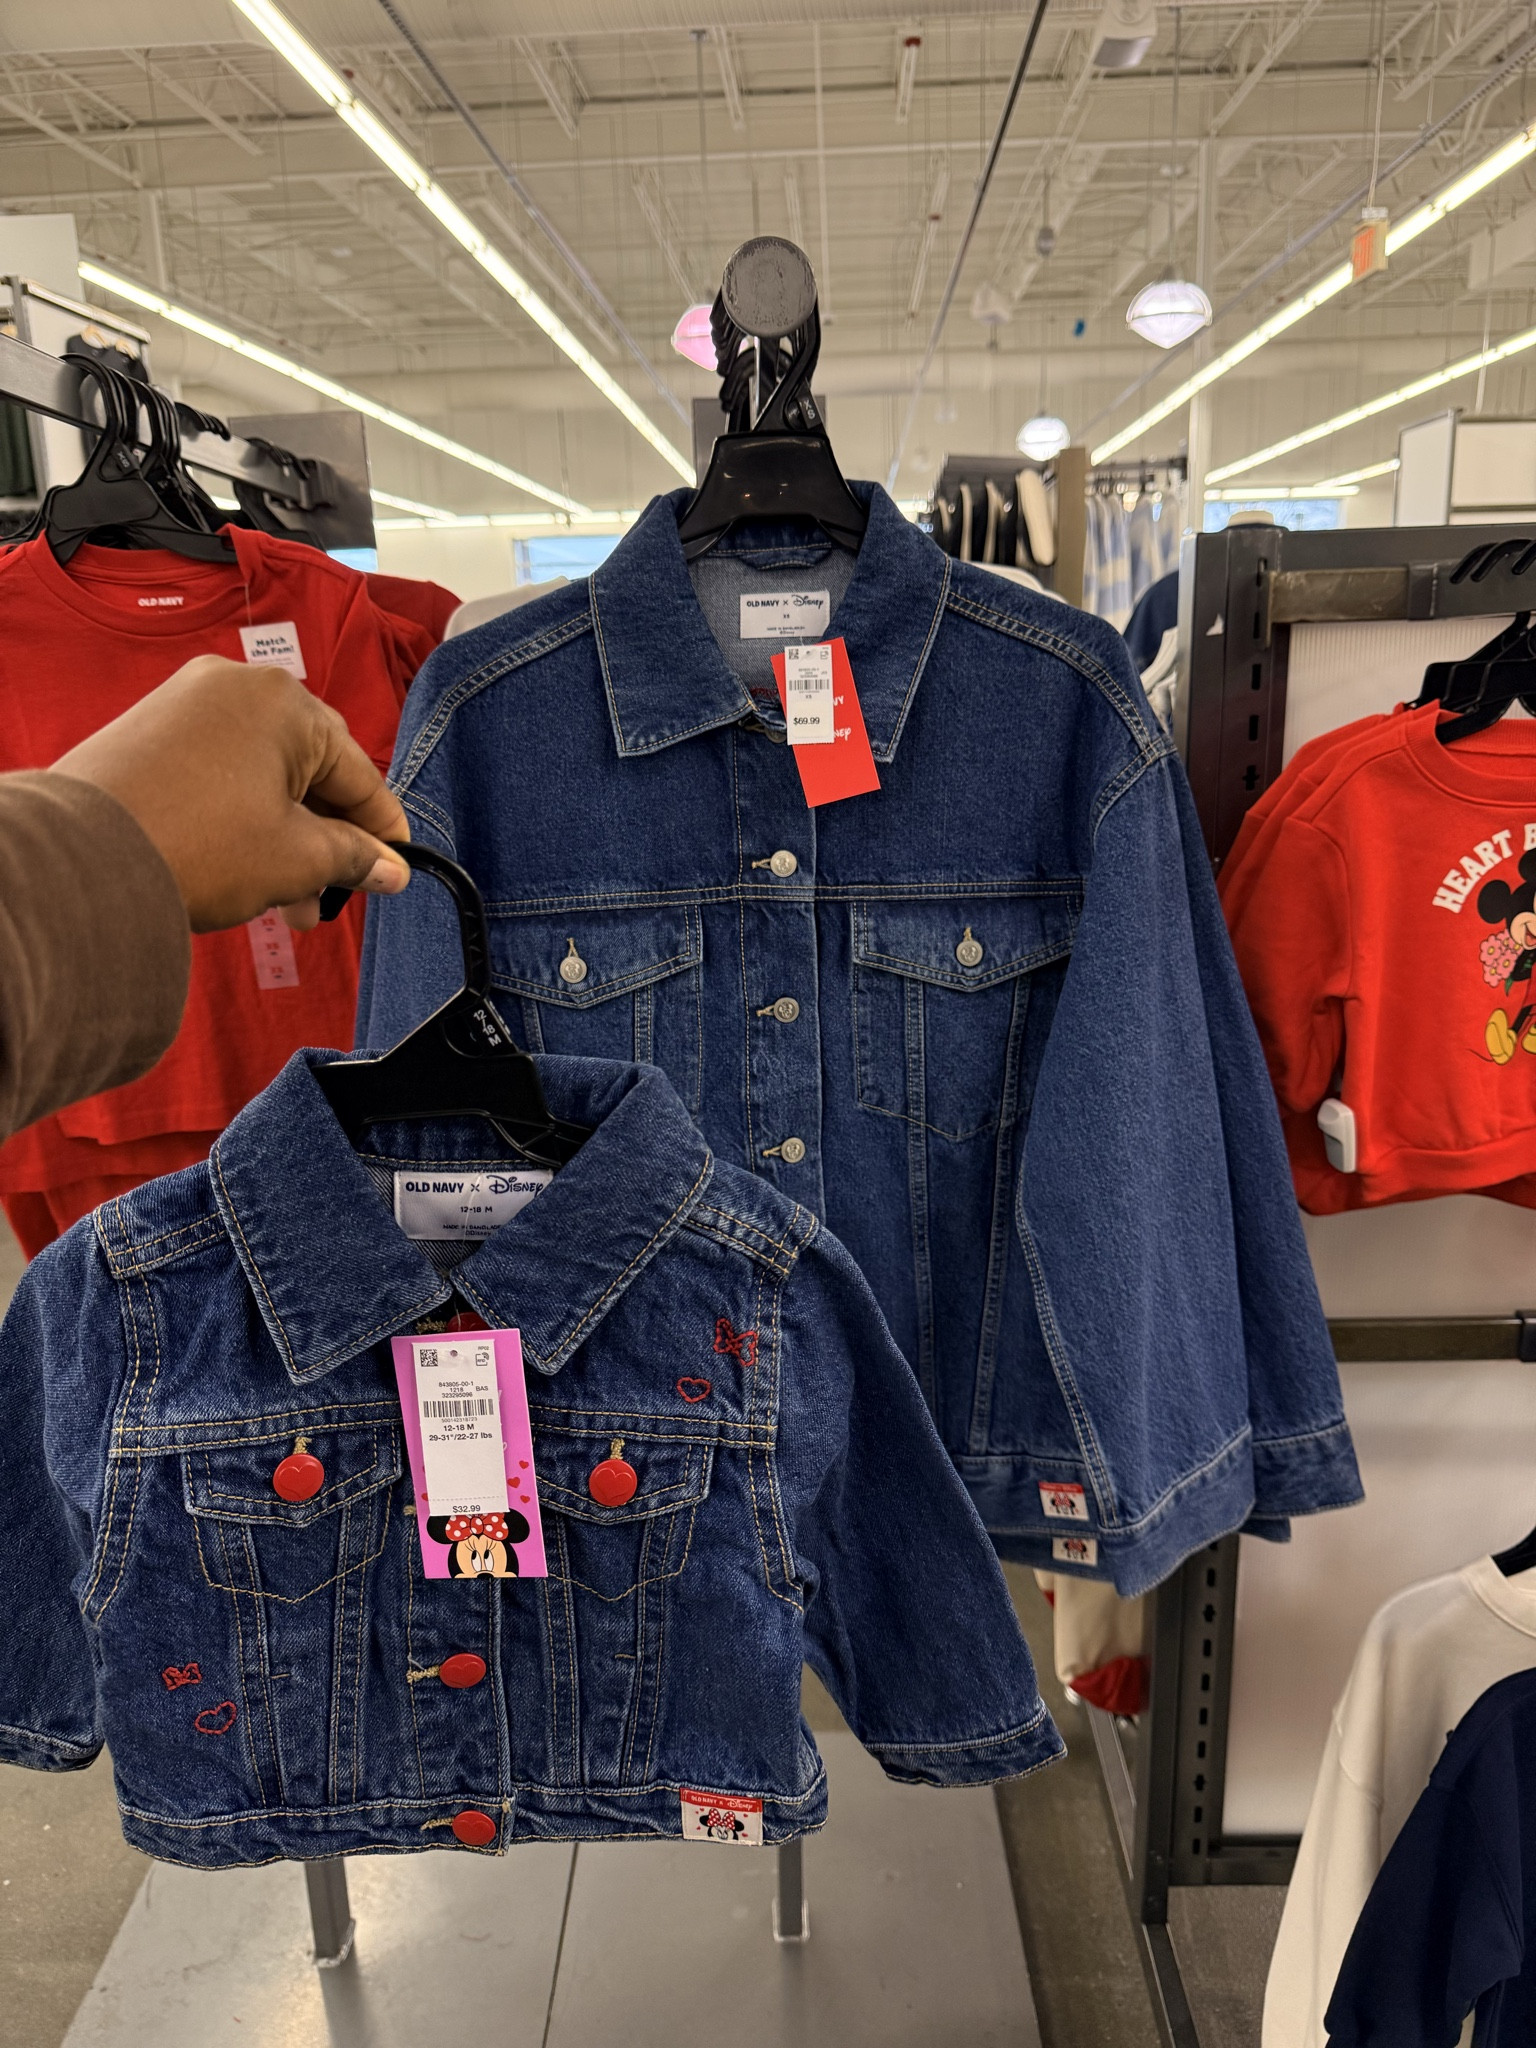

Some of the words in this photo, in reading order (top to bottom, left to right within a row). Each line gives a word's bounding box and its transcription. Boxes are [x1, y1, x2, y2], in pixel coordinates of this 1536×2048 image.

[138, 597, 157, 606] OLD
[158, 596, 184, 605] NAVY
[256, 636, 286, 647] Match
[251, 648, 268, 657] the
[793, 717, 821, 726] $69.99
[1431, 828, 1514, 915] HEART
[405, 1181, 431, 1193] OLD
[432, 1182, 465, 1194] NAVY
[486, 1174, 545, 1198] Disney
[460, 1206, 482, 1214] 12-18
[443, 1424, 465, 1432] 12-18
[480, 1431, 493, 1439] lbs
[452, 1504, 481, 1514] $32.99
[702, 1796, 717, 1804] NAVY
